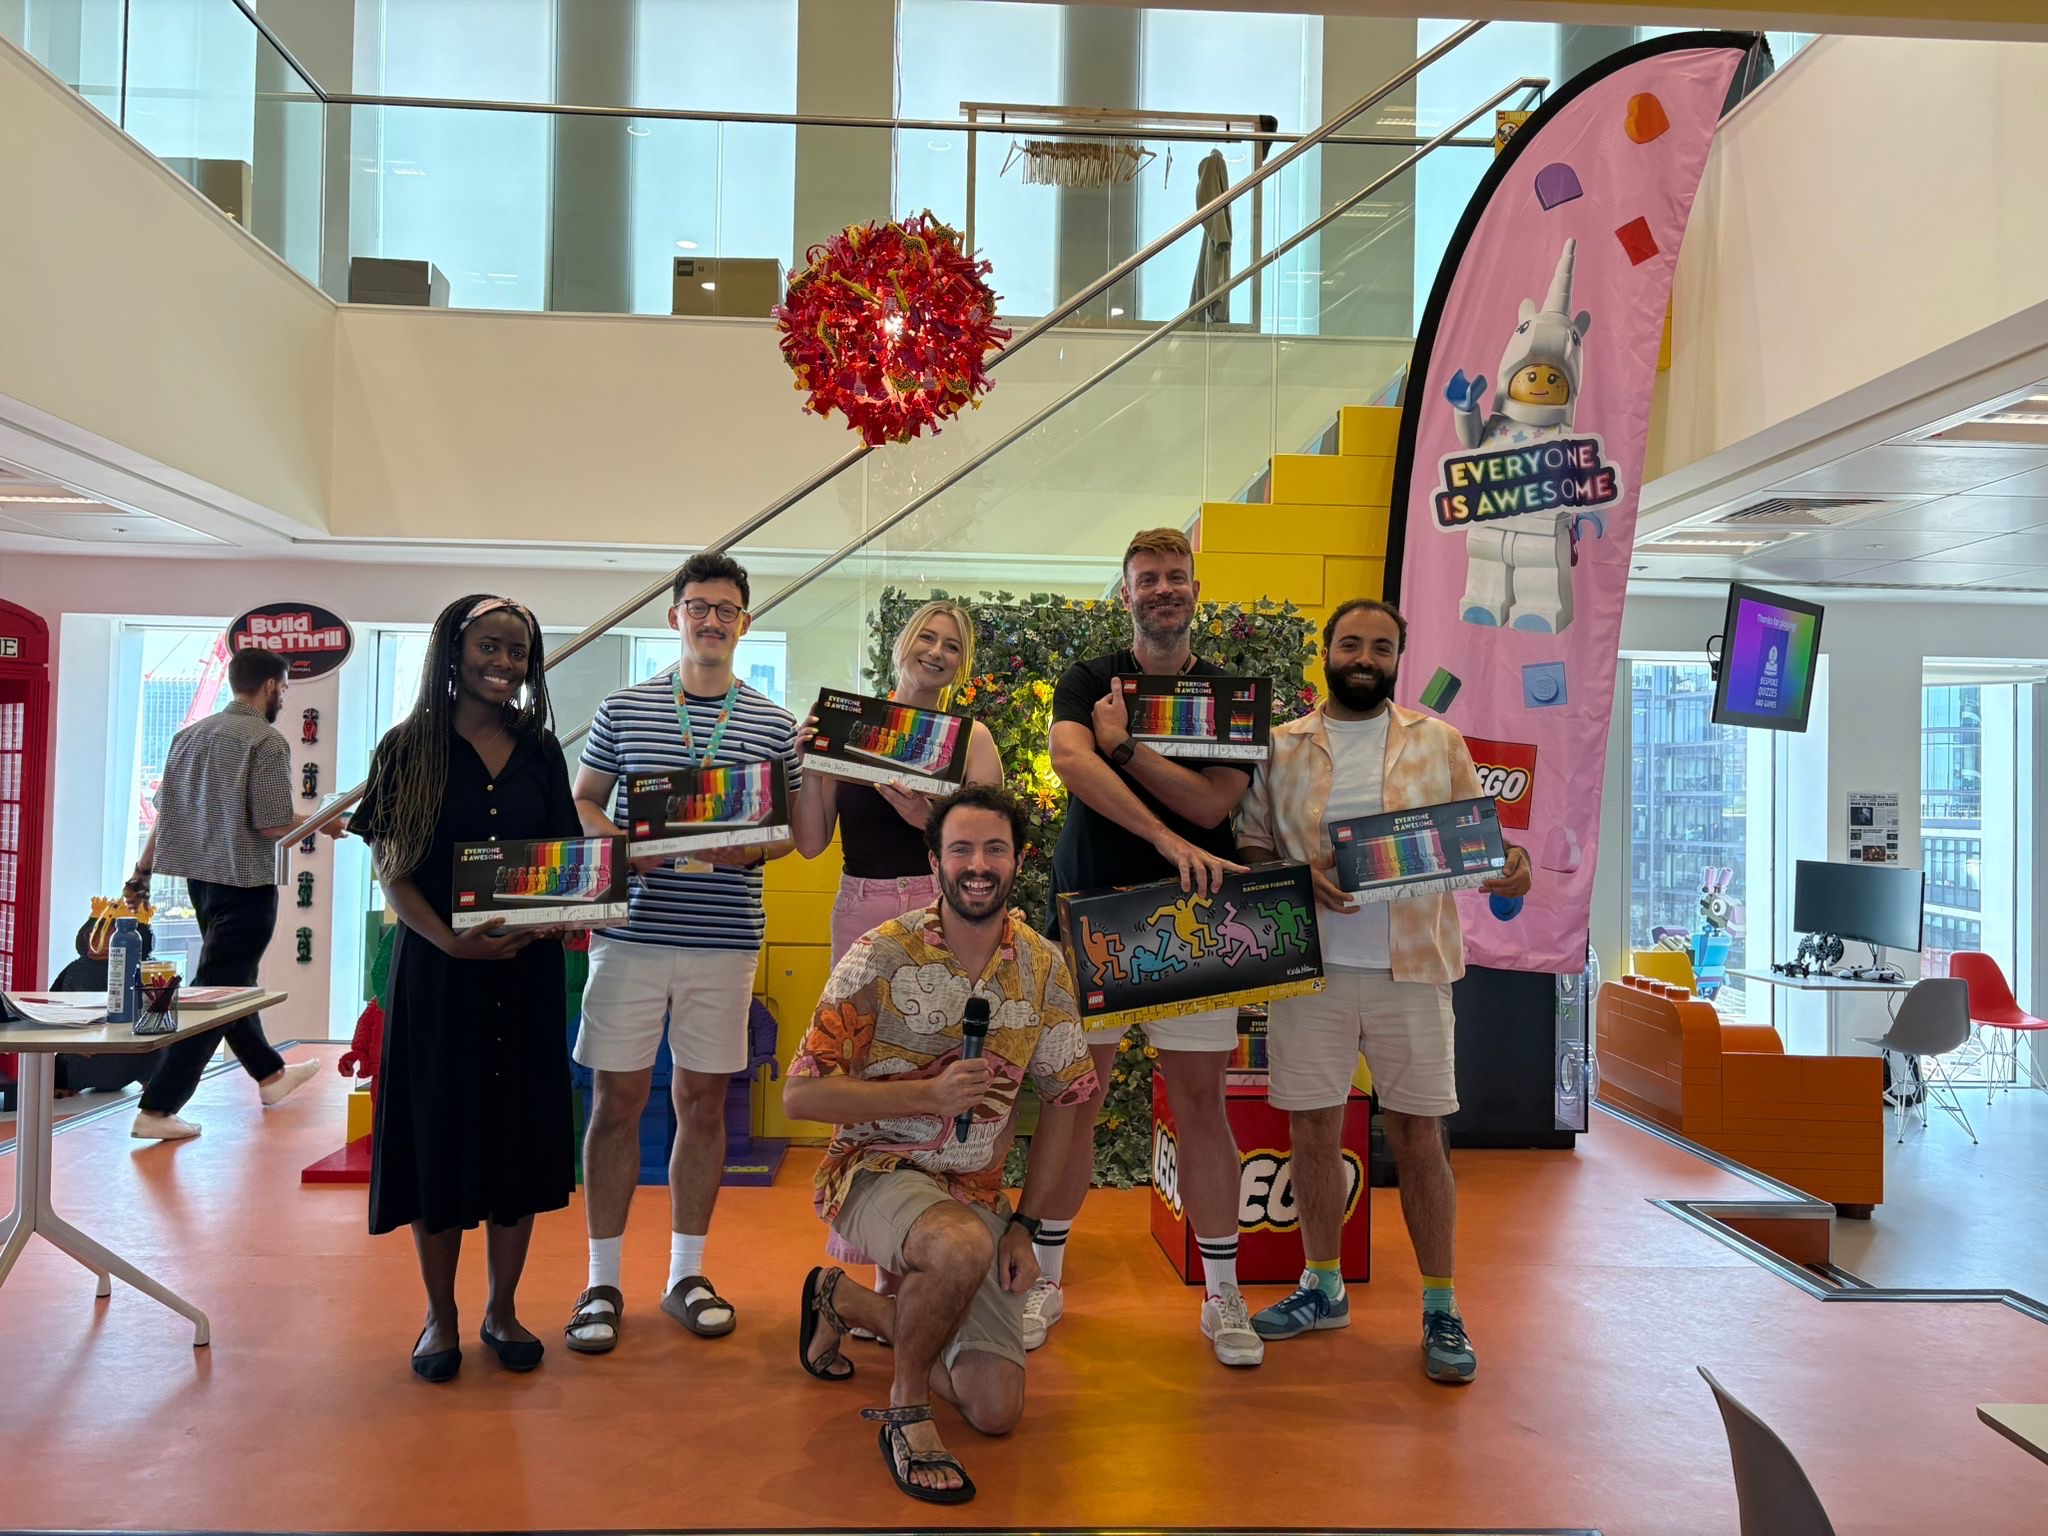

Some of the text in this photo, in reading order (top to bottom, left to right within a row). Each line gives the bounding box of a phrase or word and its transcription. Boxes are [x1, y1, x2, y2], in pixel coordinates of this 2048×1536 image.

[1449, 444, 1596, 488] EVERYONE
[1440, 472, 1613, 521] IS AWESOME
[1757, 613, 1773, 625] Thanks
[250, 616, 309, 634] Build
[1760, 676, 1779, 687] BESPOKE
[1758, 686, 1778, 697] QUIZZES
[828, 695, 861, 707] EVERYONE
[831, 702, 863, 714] AWESOME
[636, 777, 670, 786] EVERYONE
[641, 783, 673, 793] AWESOME
[1394, 813, 1430, 825] EVERYONE
[1400, 819, 1434, 831] AWESOME
[1338, 830, 1351, 838] LEGO
[464, 847, 501, 855] EVERYONE
[469, 853, 504, 861] AWESOME
[1242, 884, 1269, 893] DANCING
[1270, 879, 1296, 889] FIGURES
[1088, 995, 1104, 1004] LEGO
[1092, 1019, 1105, 1029] art
